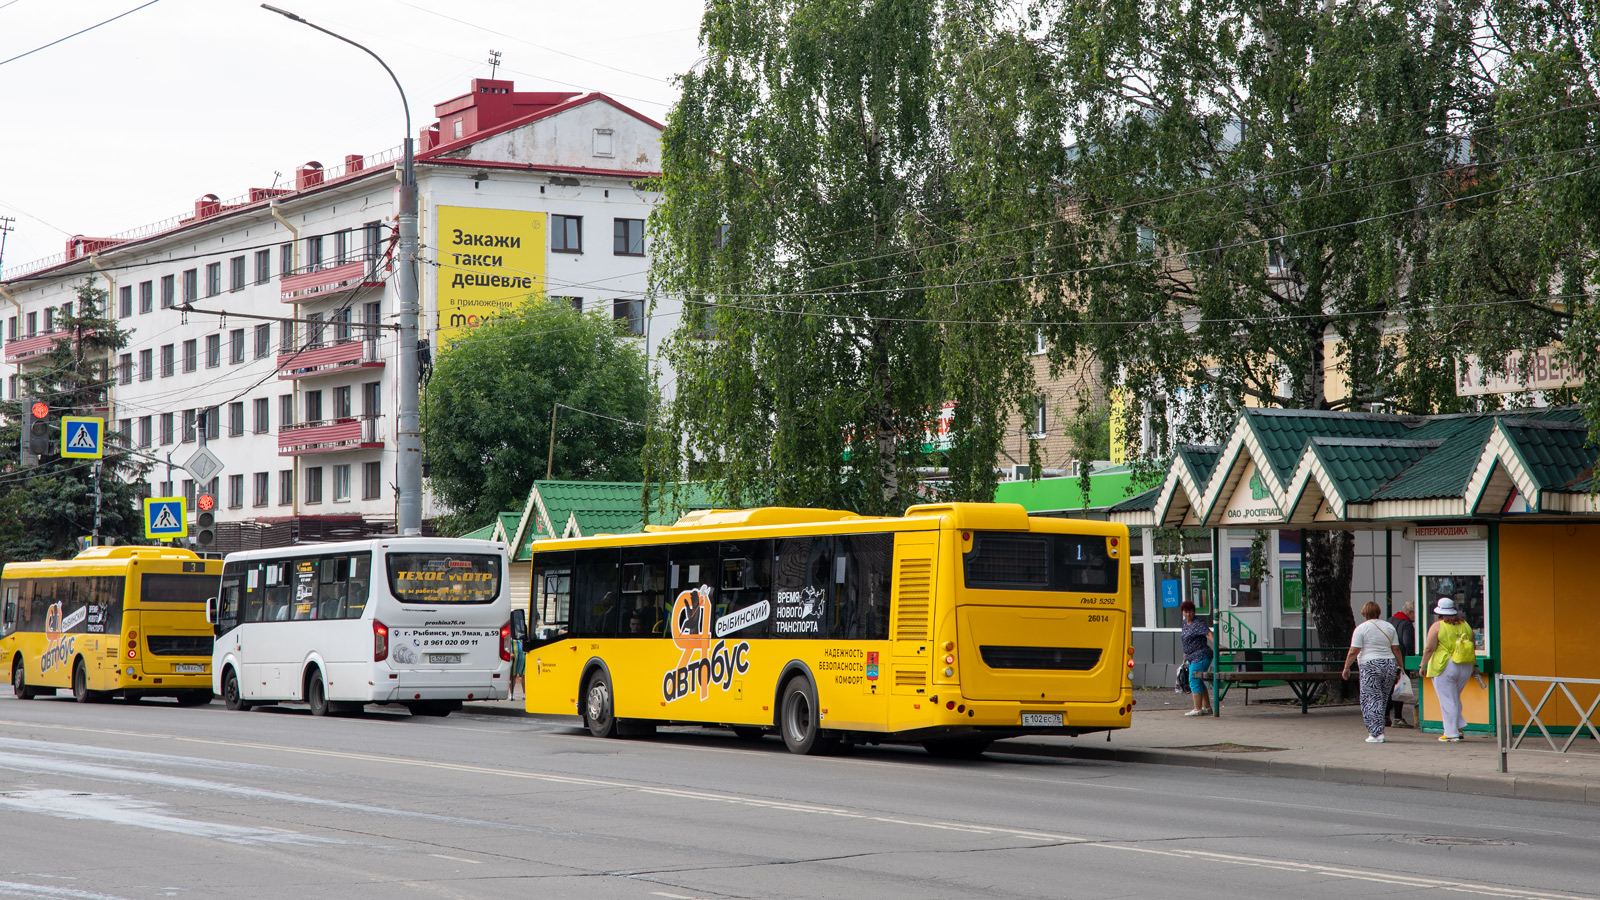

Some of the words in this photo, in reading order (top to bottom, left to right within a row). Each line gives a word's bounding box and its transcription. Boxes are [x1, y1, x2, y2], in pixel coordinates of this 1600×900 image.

[452, 229, 521, 249] Закажи
[452, 253, 503, 267] такси
[458, 299, 513, 308] приложении
[1228, 510, 1241, 518] ОАО
[1416, 527, 1468, 536] НЕПЕРИОДИКА
[1076, 544, 1082, 560] 1
[190, 562, 196, 572] 3
[778, 592, 800, 604] ВРЕМЯ
[776, 606, 802, 618] НОВОГО
[717, 602, 768, 634] РЫБИНСКИЙ
[776, 621, 818, 632] ТРАНСПОРТА
[824, 648, 863, 658] НАДЕЖНОСТЬ
[664, 640, 749, 701] автобус
[819, 662, 863, 671] БЕЗОПАСНОСТЬ
[835, 676, 863, 684] КОМФОРТ
